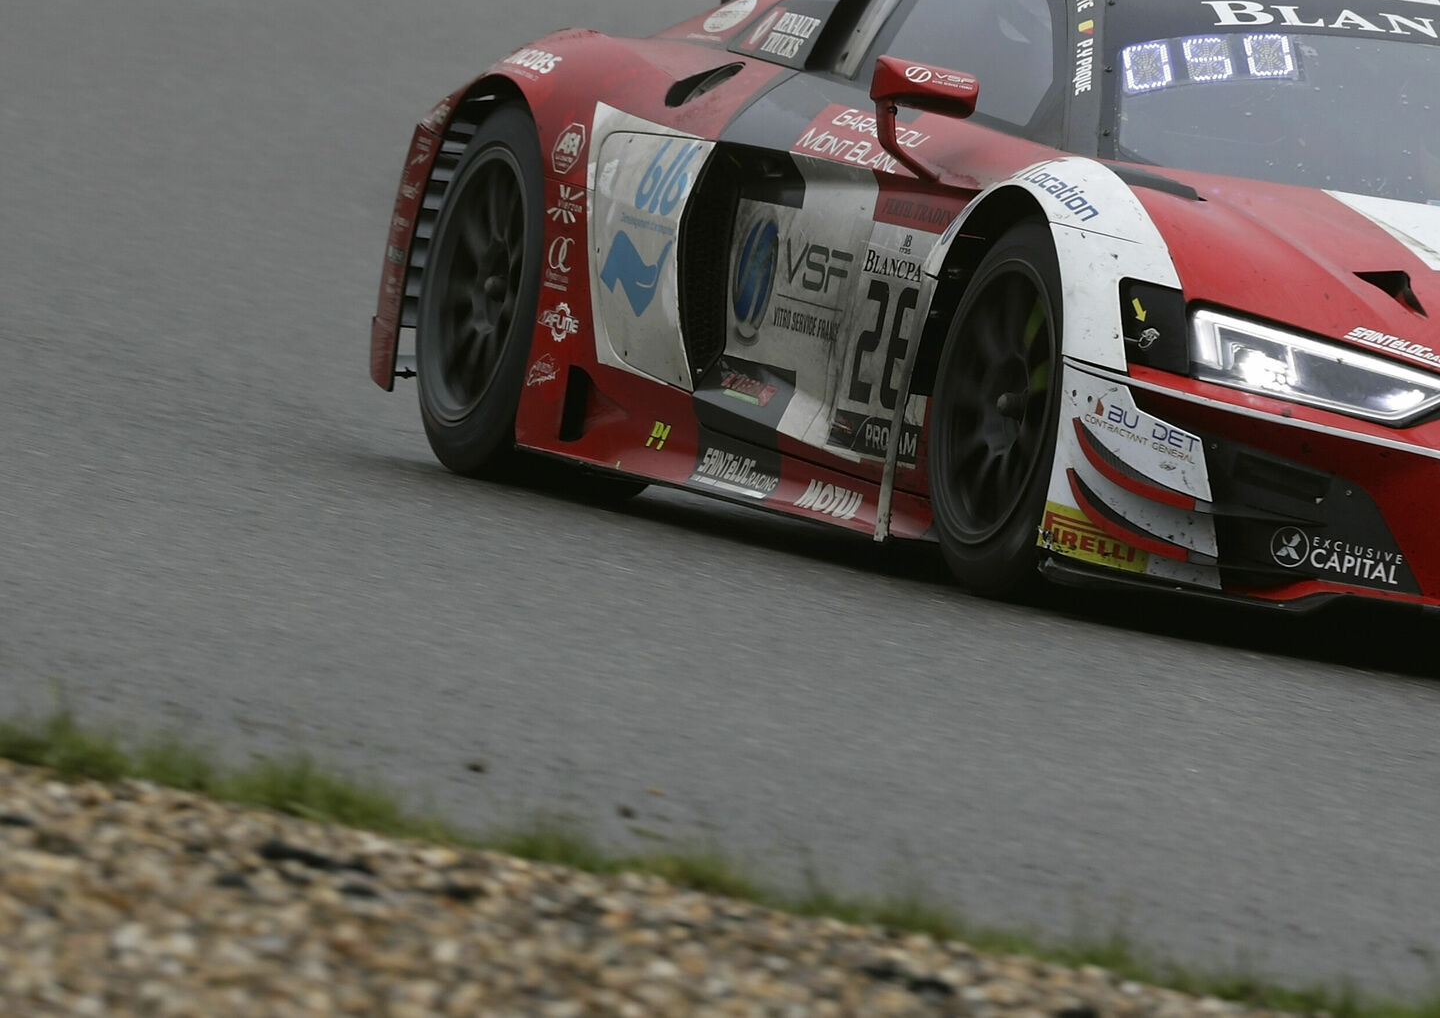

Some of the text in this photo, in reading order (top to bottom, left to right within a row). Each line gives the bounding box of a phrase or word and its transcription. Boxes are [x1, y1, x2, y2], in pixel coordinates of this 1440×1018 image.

[773, 11, 822, 39] RENAULT
[760, 32, 805, 59] TRUCKS
[831, 108, 906, 139] GARA
[796, 127, 854, 157] MONT
[785, 237, 854, 294] VSF
[863, 249, 922, 282] BLANCPA
[865, 421, 918, 458] PROM
[1084, 413, 1149, 446] CONTRACTANT
[793, 478, 865, 521] MOTUL
[1309, 548, 1399, 586] CAPITAL
[1312, 535, 1404, 566] EXCLUSIVE
